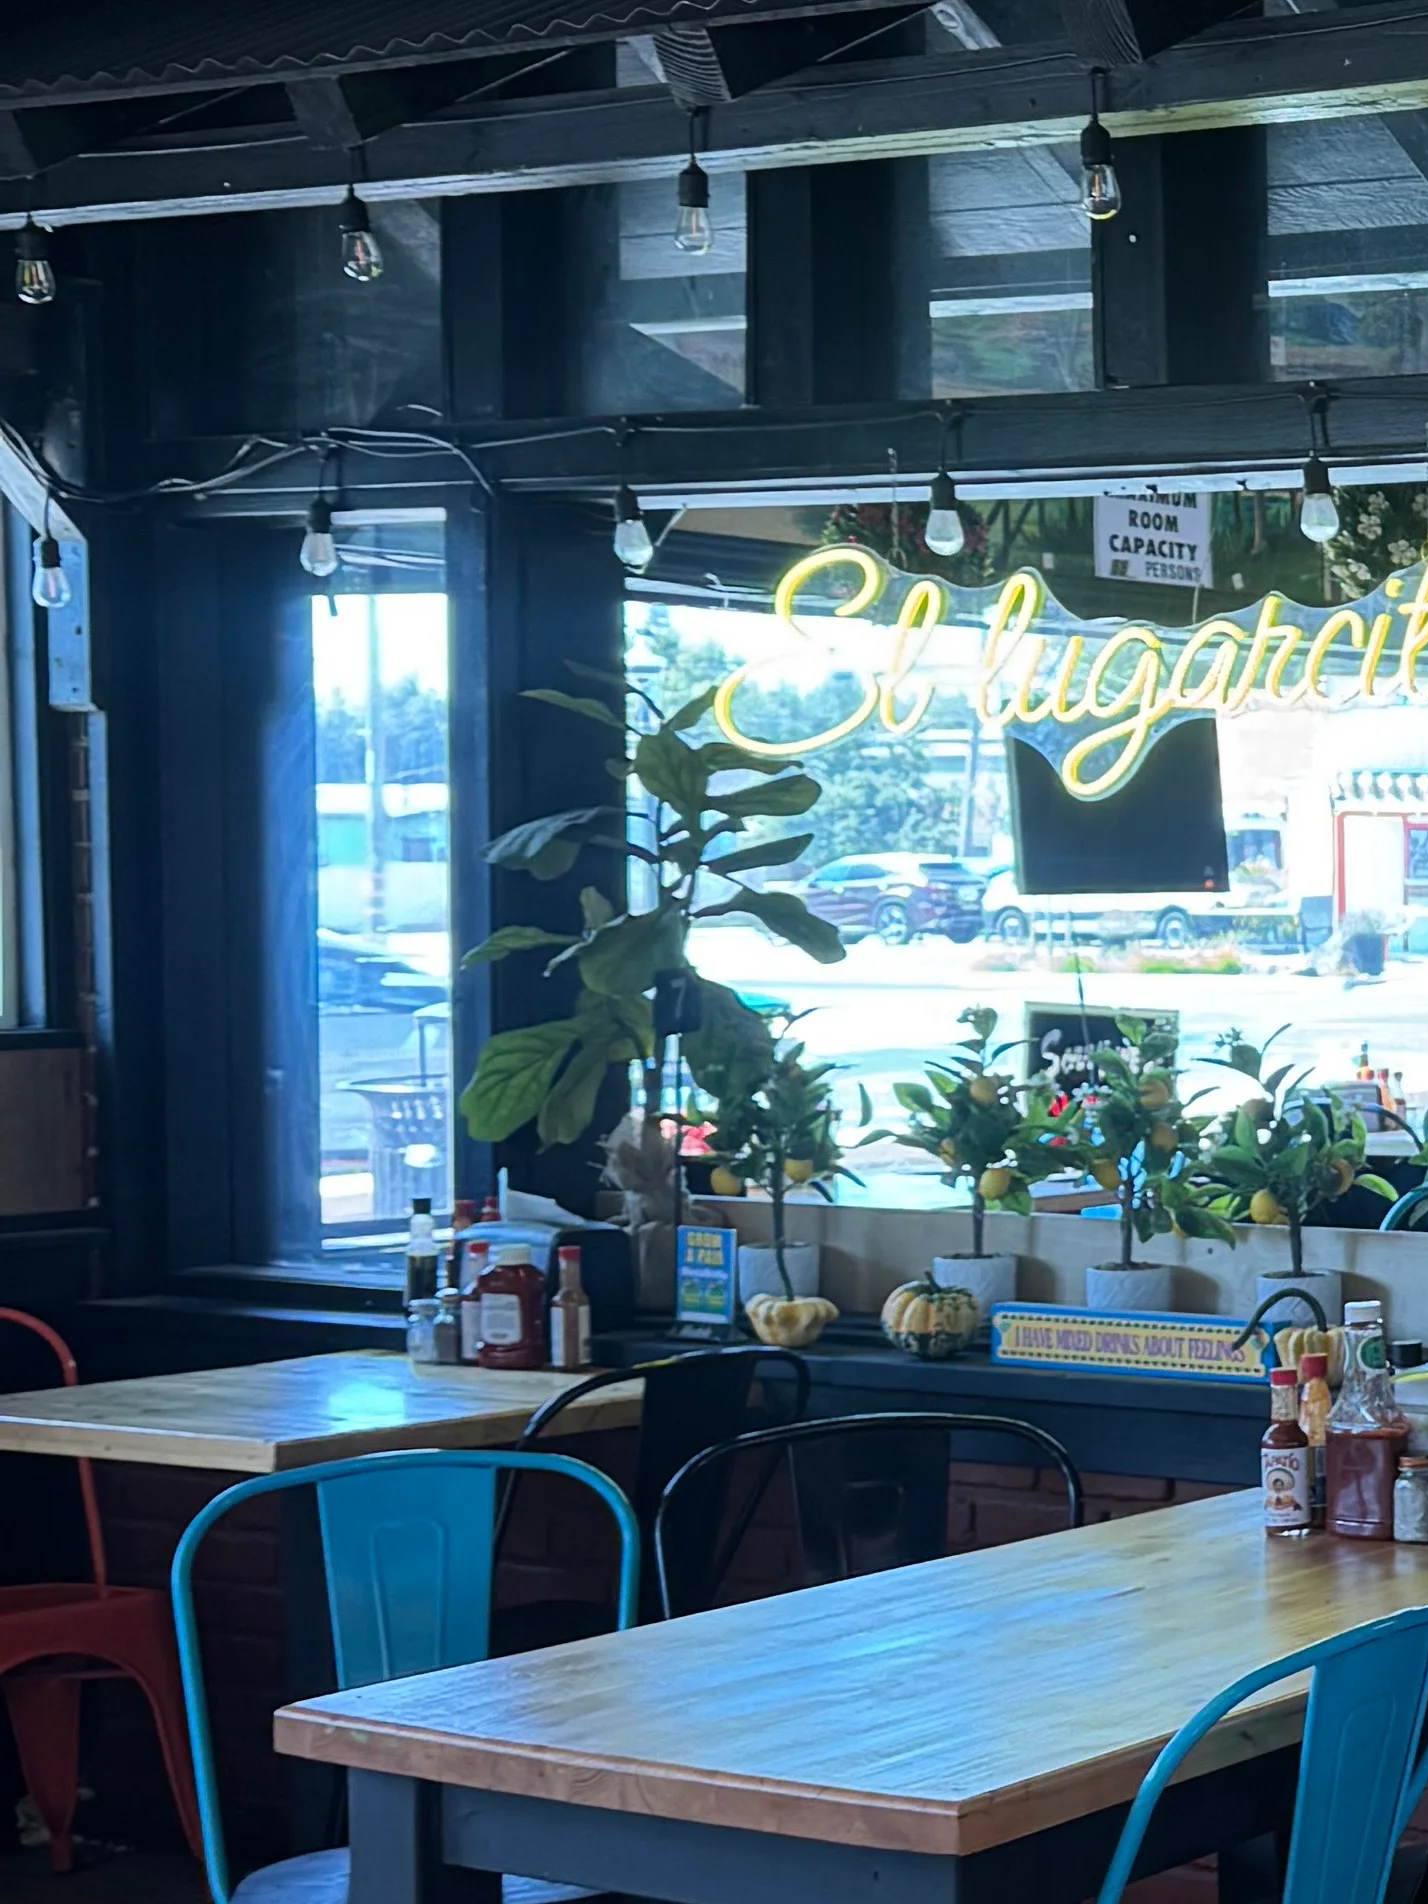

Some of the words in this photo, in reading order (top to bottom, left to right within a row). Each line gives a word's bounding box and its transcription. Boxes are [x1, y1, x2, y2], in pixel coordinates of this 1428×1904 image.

[1128, 509, 1179, 533] ROOM
[1109, 534, 1198, 561] CAPACITY
[1145, 561, 1201, 582] PERSONS
[715, 544, 947, 758] El
[669, 977, 687, 1018] 7
[1015, 1325, 1021, 1347] I
[1022, 1326, 1053, 1349] HAVE
[1096, 1331, 1141, 1355] DRINKS
[1144, 1335, 1186, 1359] ABOUT
